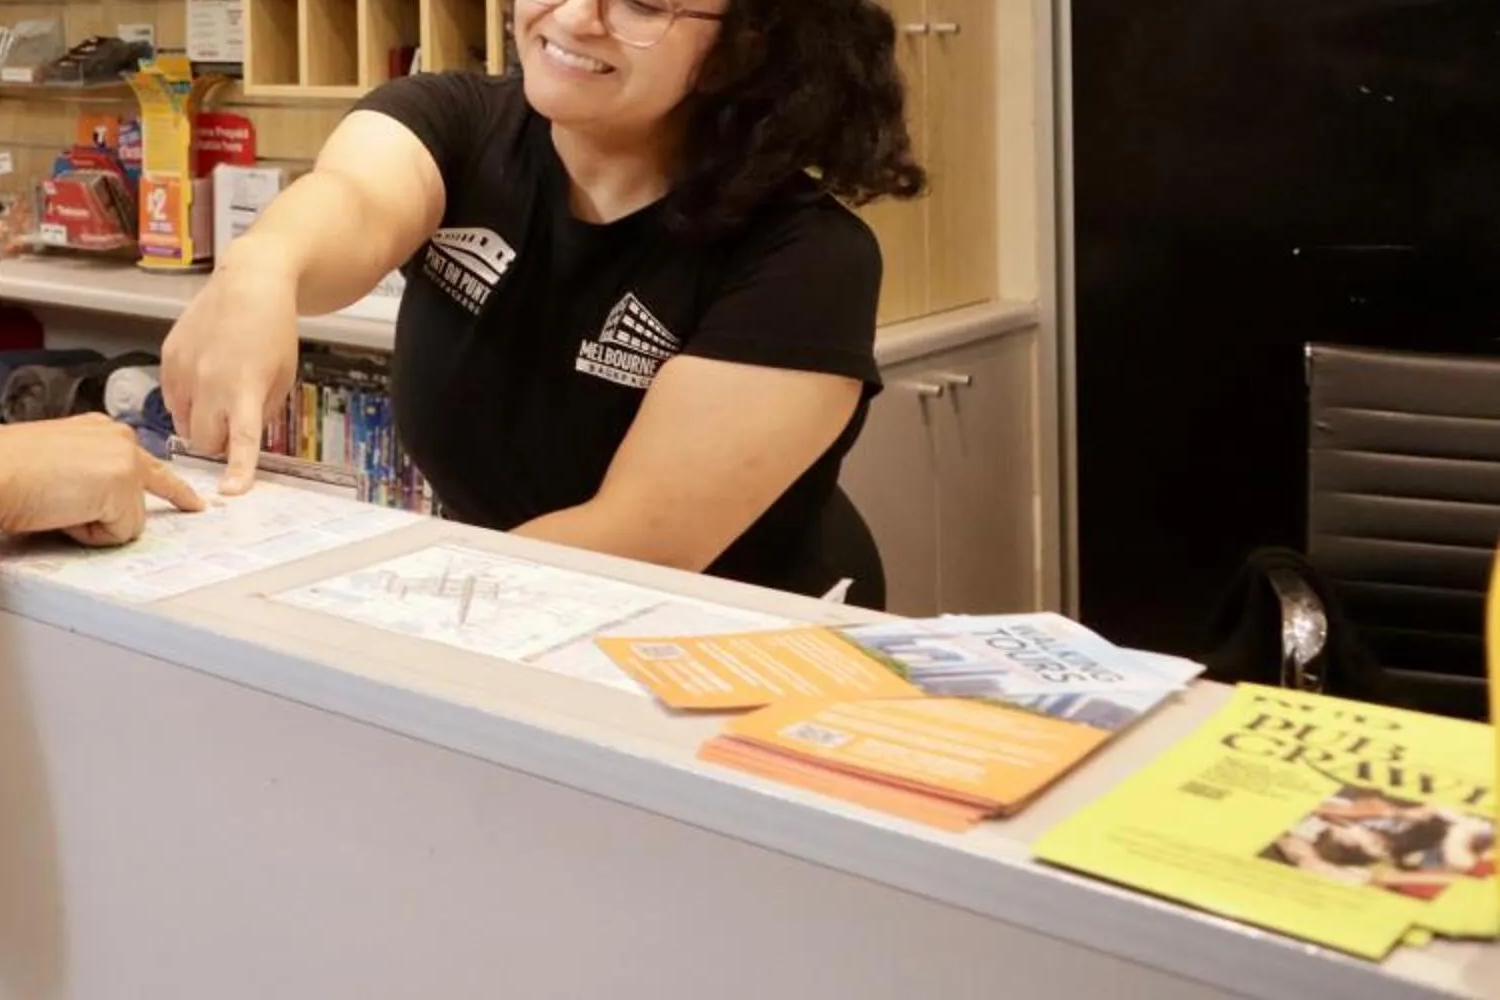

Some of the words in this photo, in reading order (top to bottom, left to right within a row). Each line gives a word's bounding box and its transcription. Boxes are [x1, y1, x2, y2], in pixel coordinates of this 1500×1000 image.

[459, 271, 492, 305] PUNT
[579, 338, 660, 377] MELBOURNE
[971, 629, 1087, 684] TOURS
[1243, 713, 1407, 762] PUB
